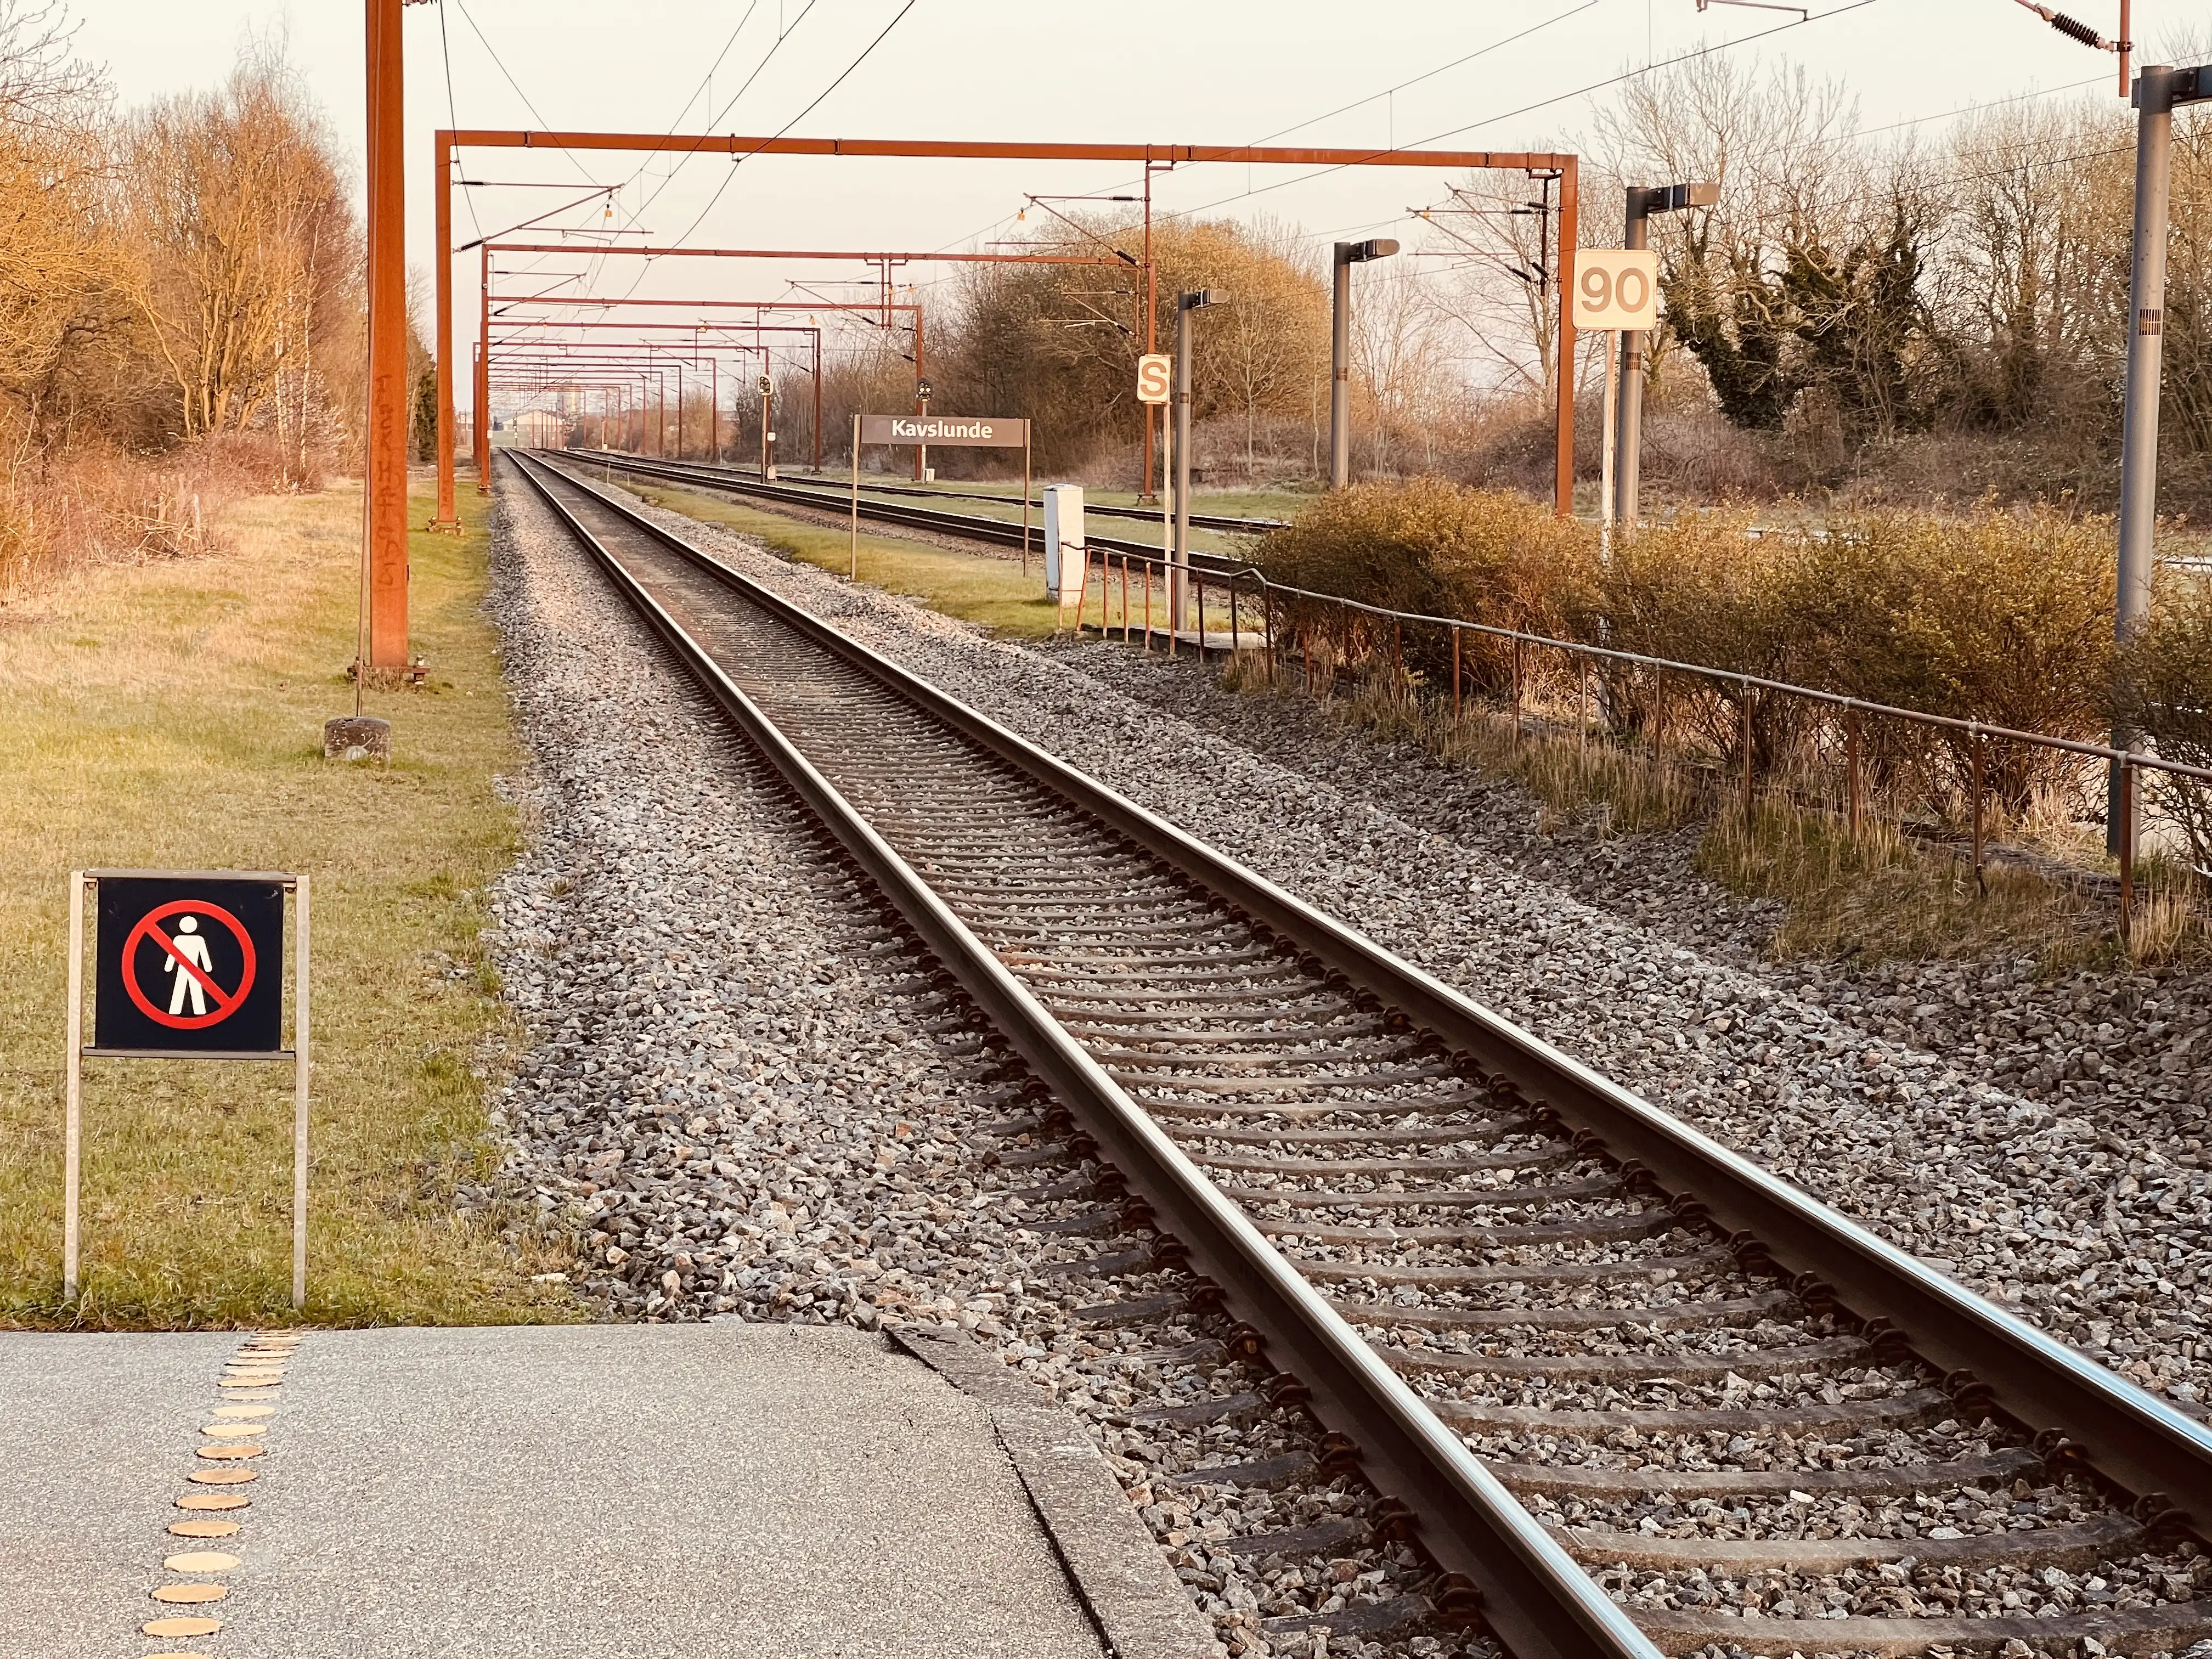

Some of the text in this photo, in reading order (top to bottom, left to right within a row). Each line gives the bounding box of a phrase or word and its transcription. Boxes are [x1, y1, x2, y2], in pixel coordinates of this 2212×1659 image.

[1581, 267, 1649, 313] 90
[1140, 362, 1167, 397] S
[891, 419, 992, 438] Kavslunde
